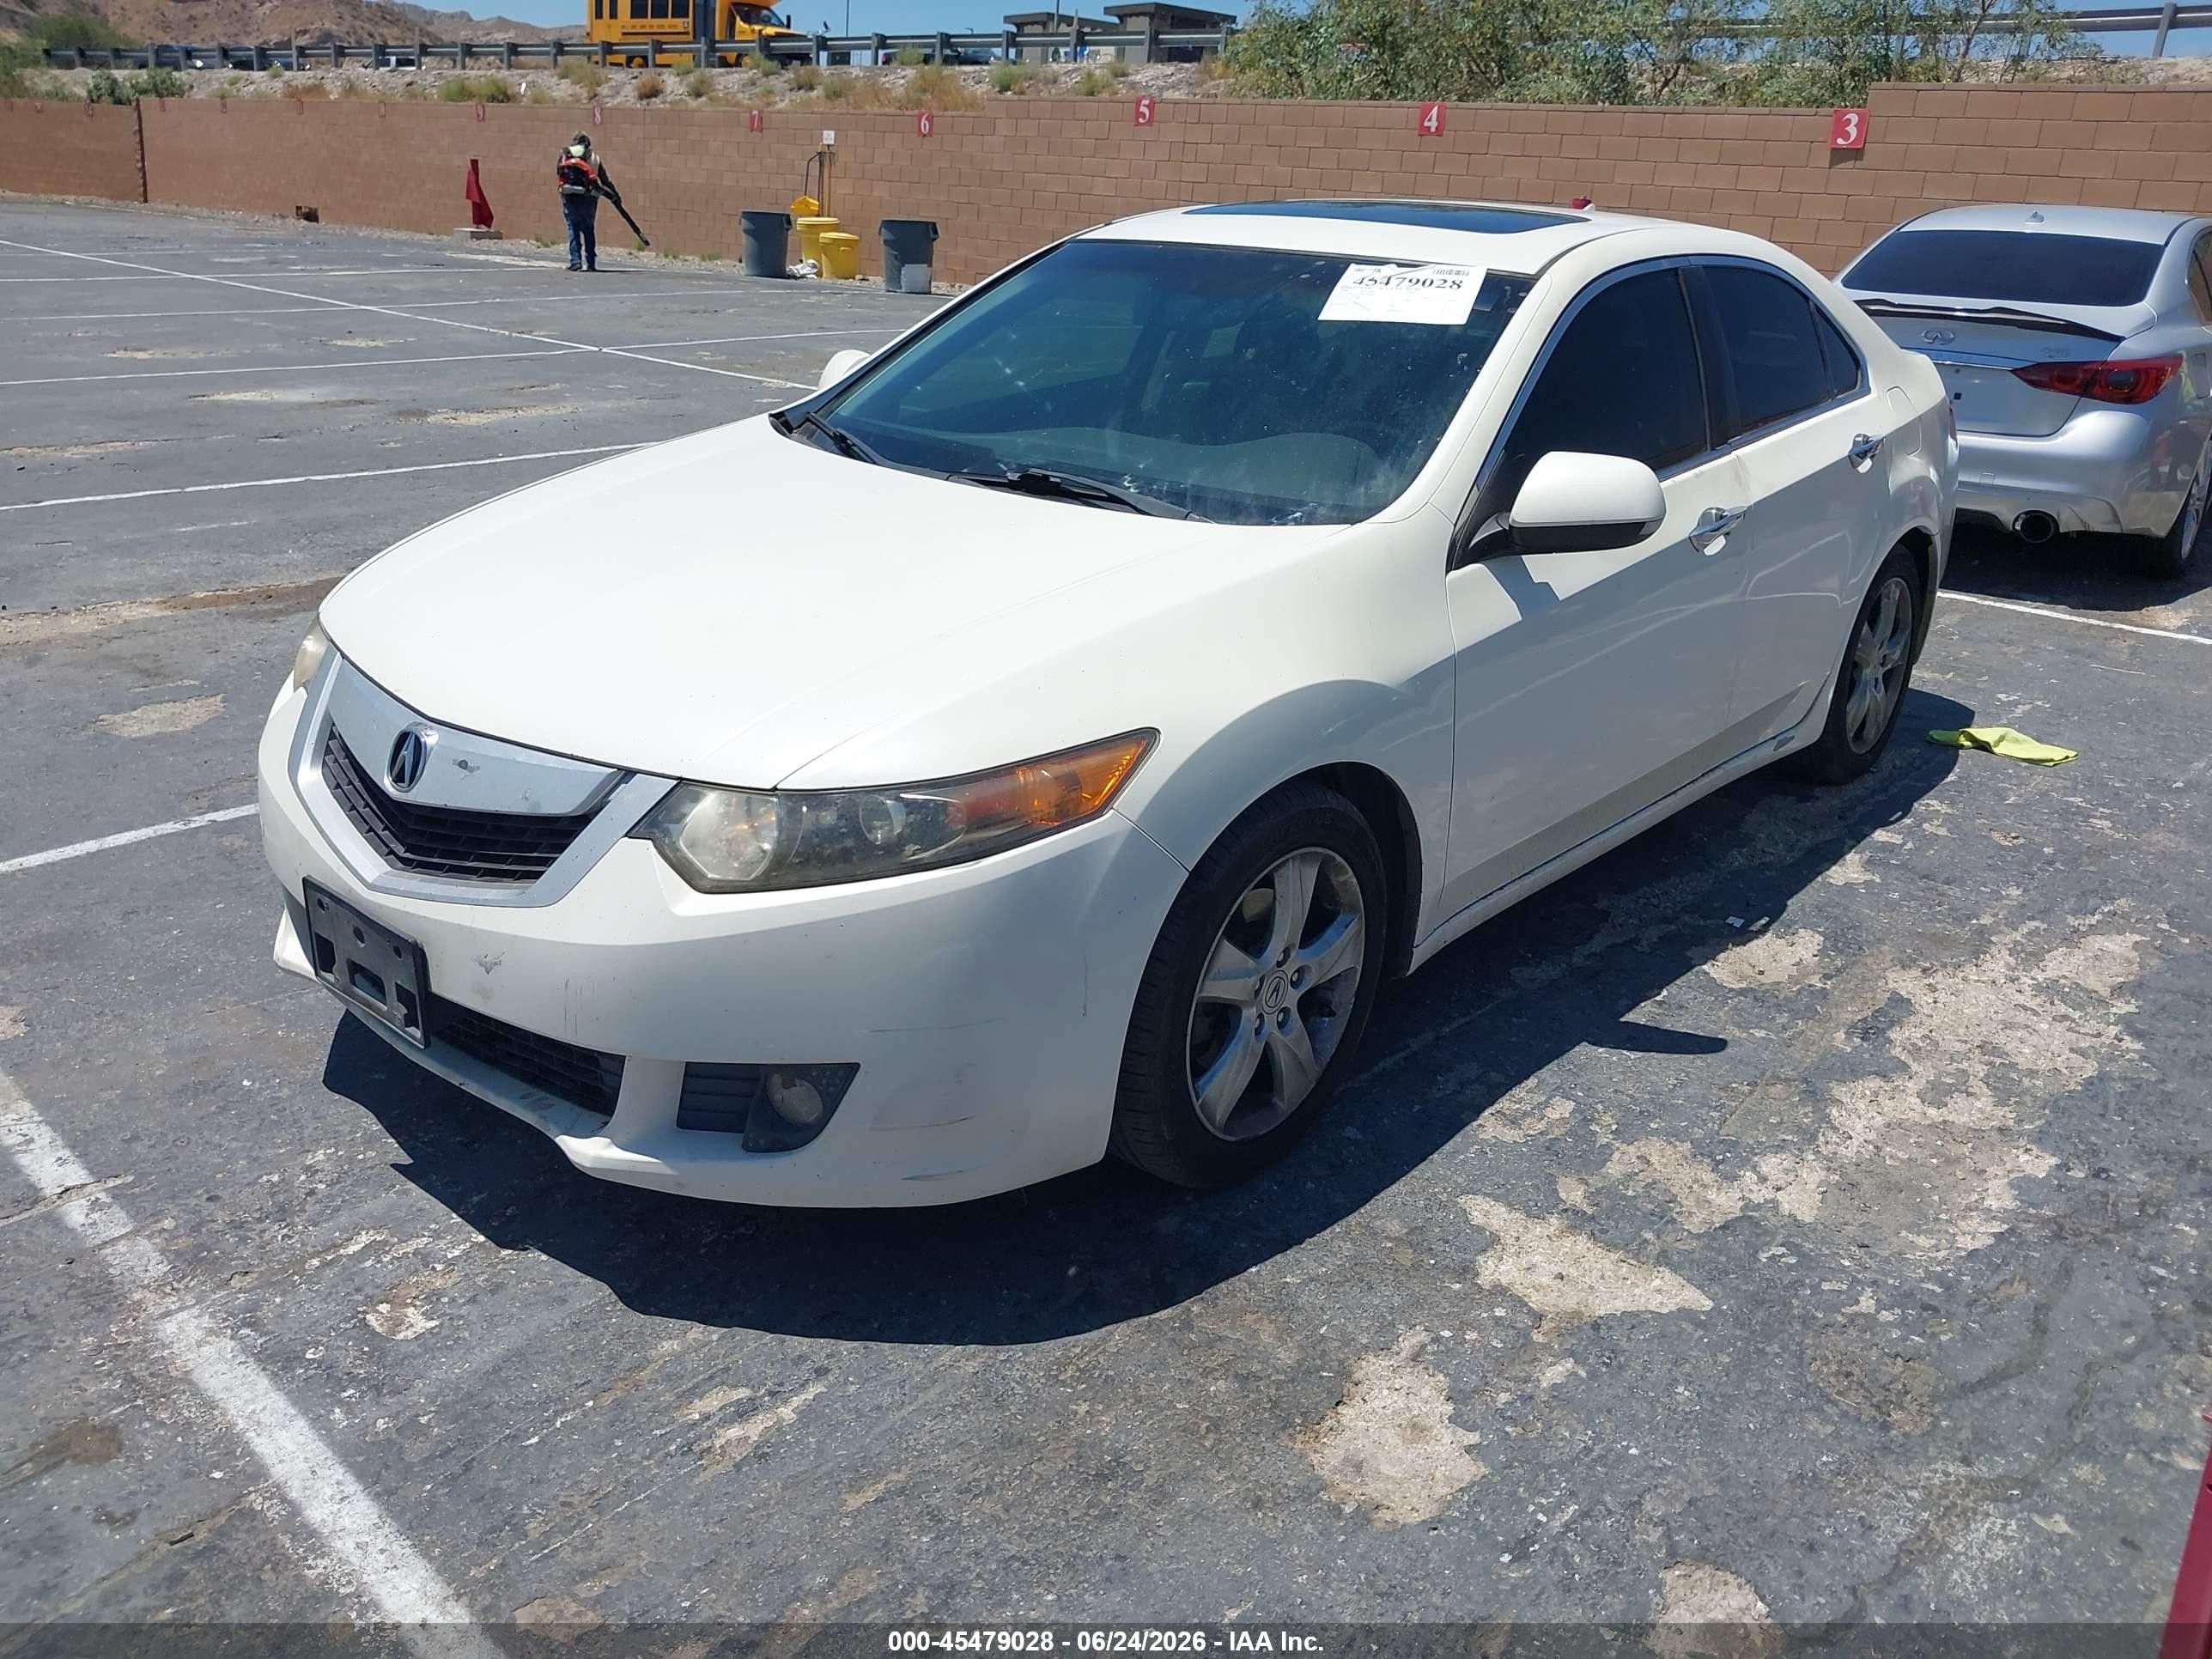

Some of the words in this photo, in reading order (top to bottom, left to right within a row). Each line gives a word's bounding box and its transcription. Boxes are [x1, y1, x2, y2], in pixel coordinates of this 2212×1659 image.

[594, 106, 601, 125] 8
[751, 110, 758, 129] 7
[1139, 99, 1150, 124] 5
[1423, 105, 1438, 132] 4
[921, 112, 929, 134] 6
[1836, 112, 1859, 145] 3
[1352, 275, 1463, 289] 45479028
